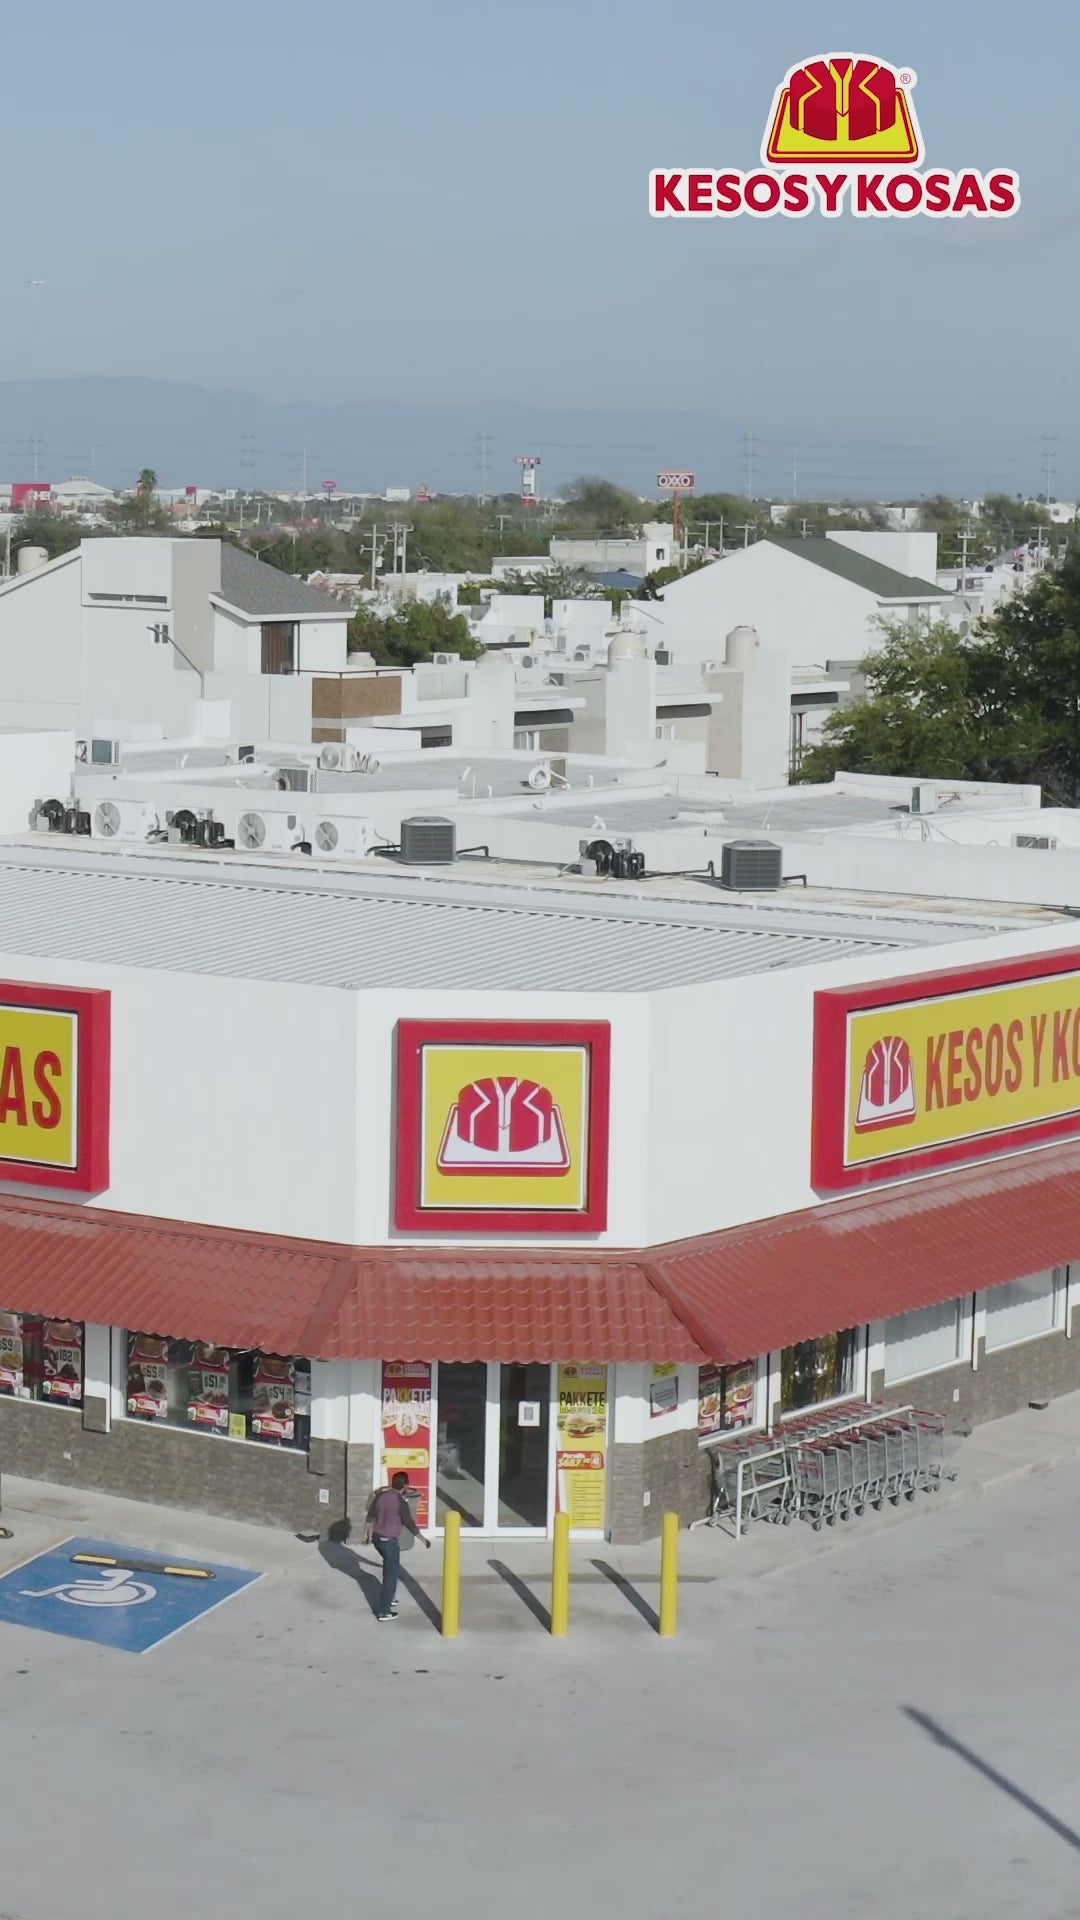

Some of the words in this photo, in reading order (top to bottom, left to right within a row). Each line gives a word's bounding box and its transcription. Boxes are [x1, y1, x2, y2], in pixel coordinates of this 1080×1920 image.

[658, 474, 691, 488] OXXO
[925, 1018, 1024, 1112] KESOS
[1030, 1013, 1047, 1088] Y
[559, 1391, 606, 1407] PAKKETE
